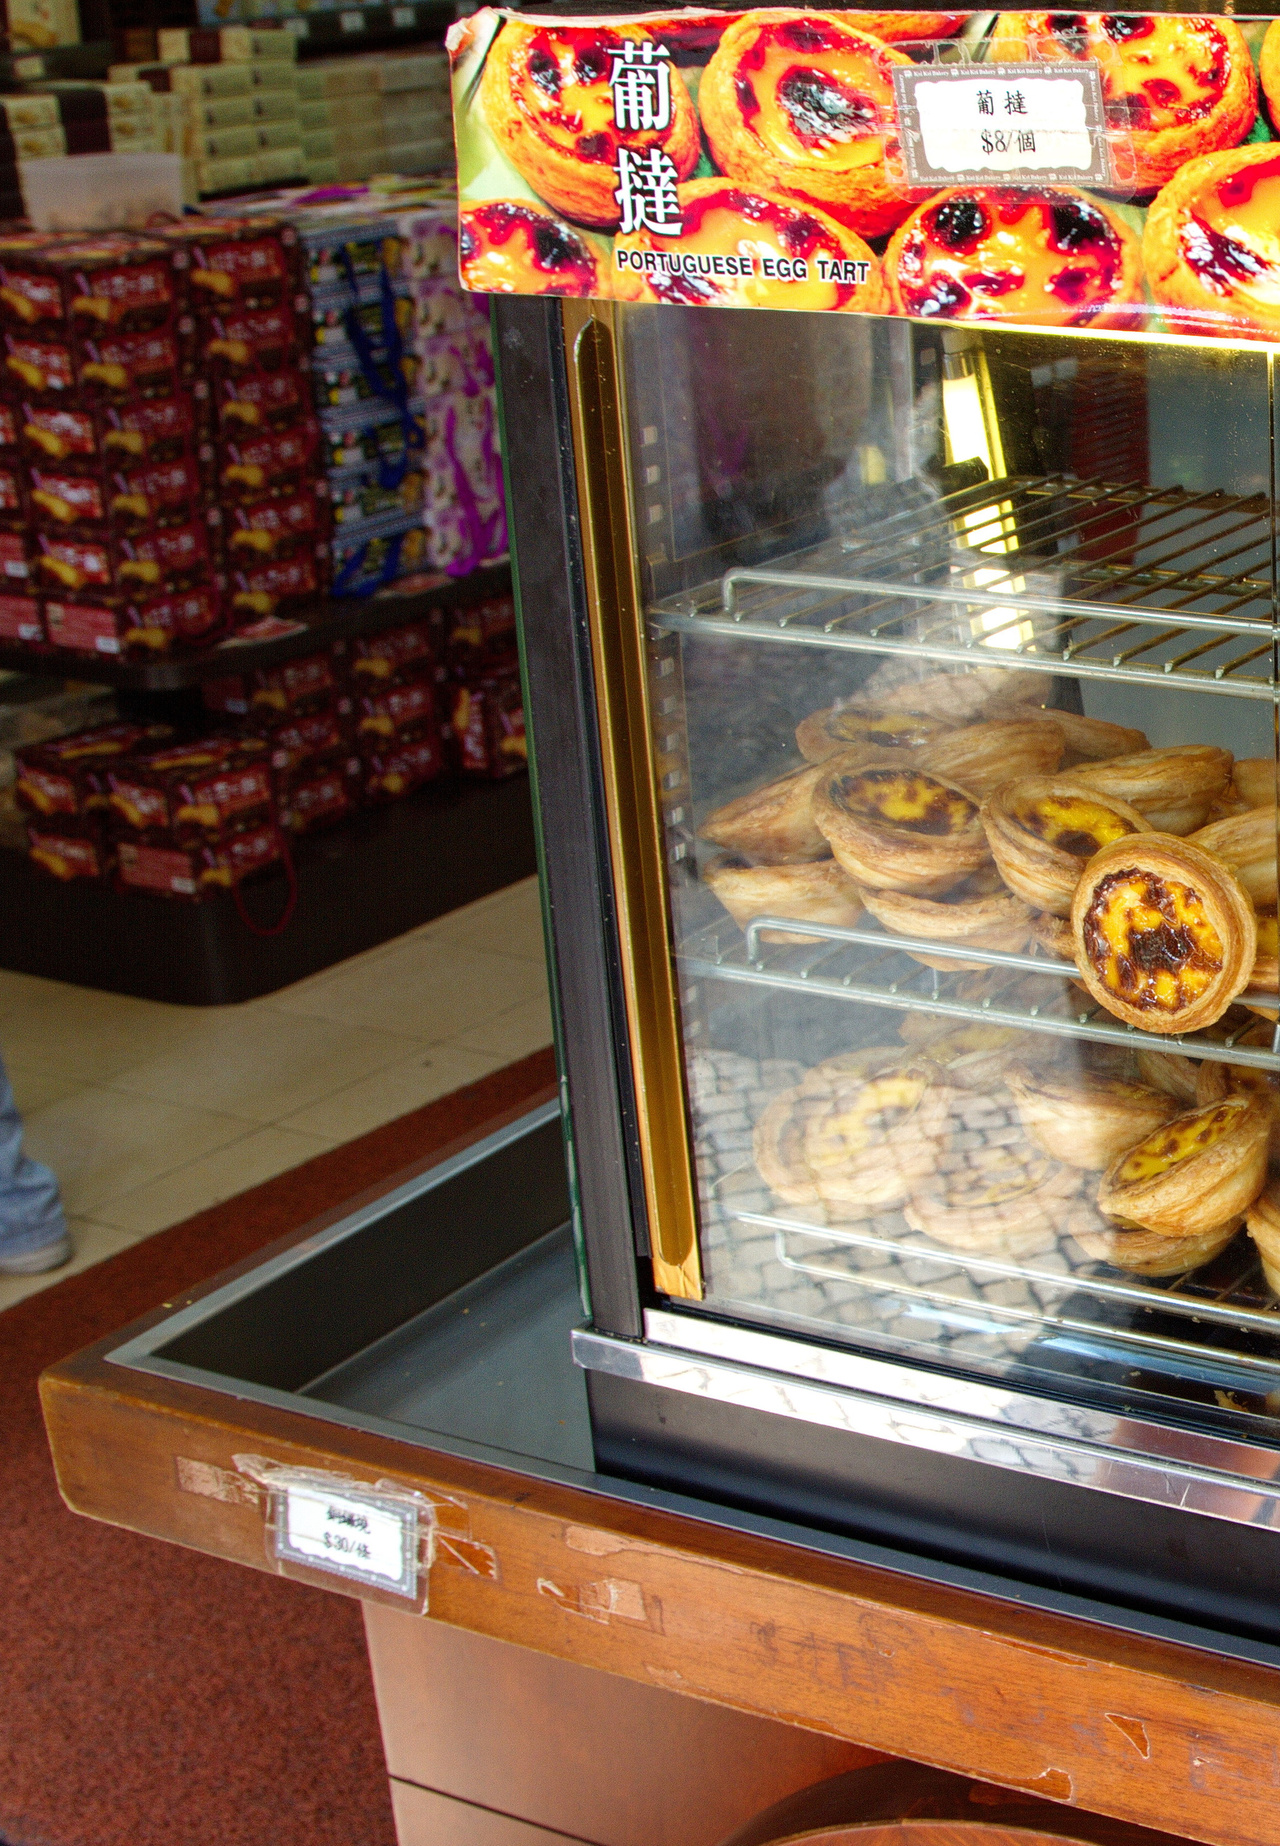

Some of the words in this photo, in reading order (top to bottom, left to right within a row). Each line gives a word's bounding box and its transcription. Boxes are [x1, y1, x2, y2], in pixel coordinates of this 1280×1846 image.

[976, 89, 1029, 116] 葡撻
[608, 41, 683, 235] 葡撻
[981, 128, 1036, 155] $8/個
[618, 250, 752, 276] PORTUGUESE
[764, 257, 806, 279] EGG
[818, 260, 869, 282] TART
